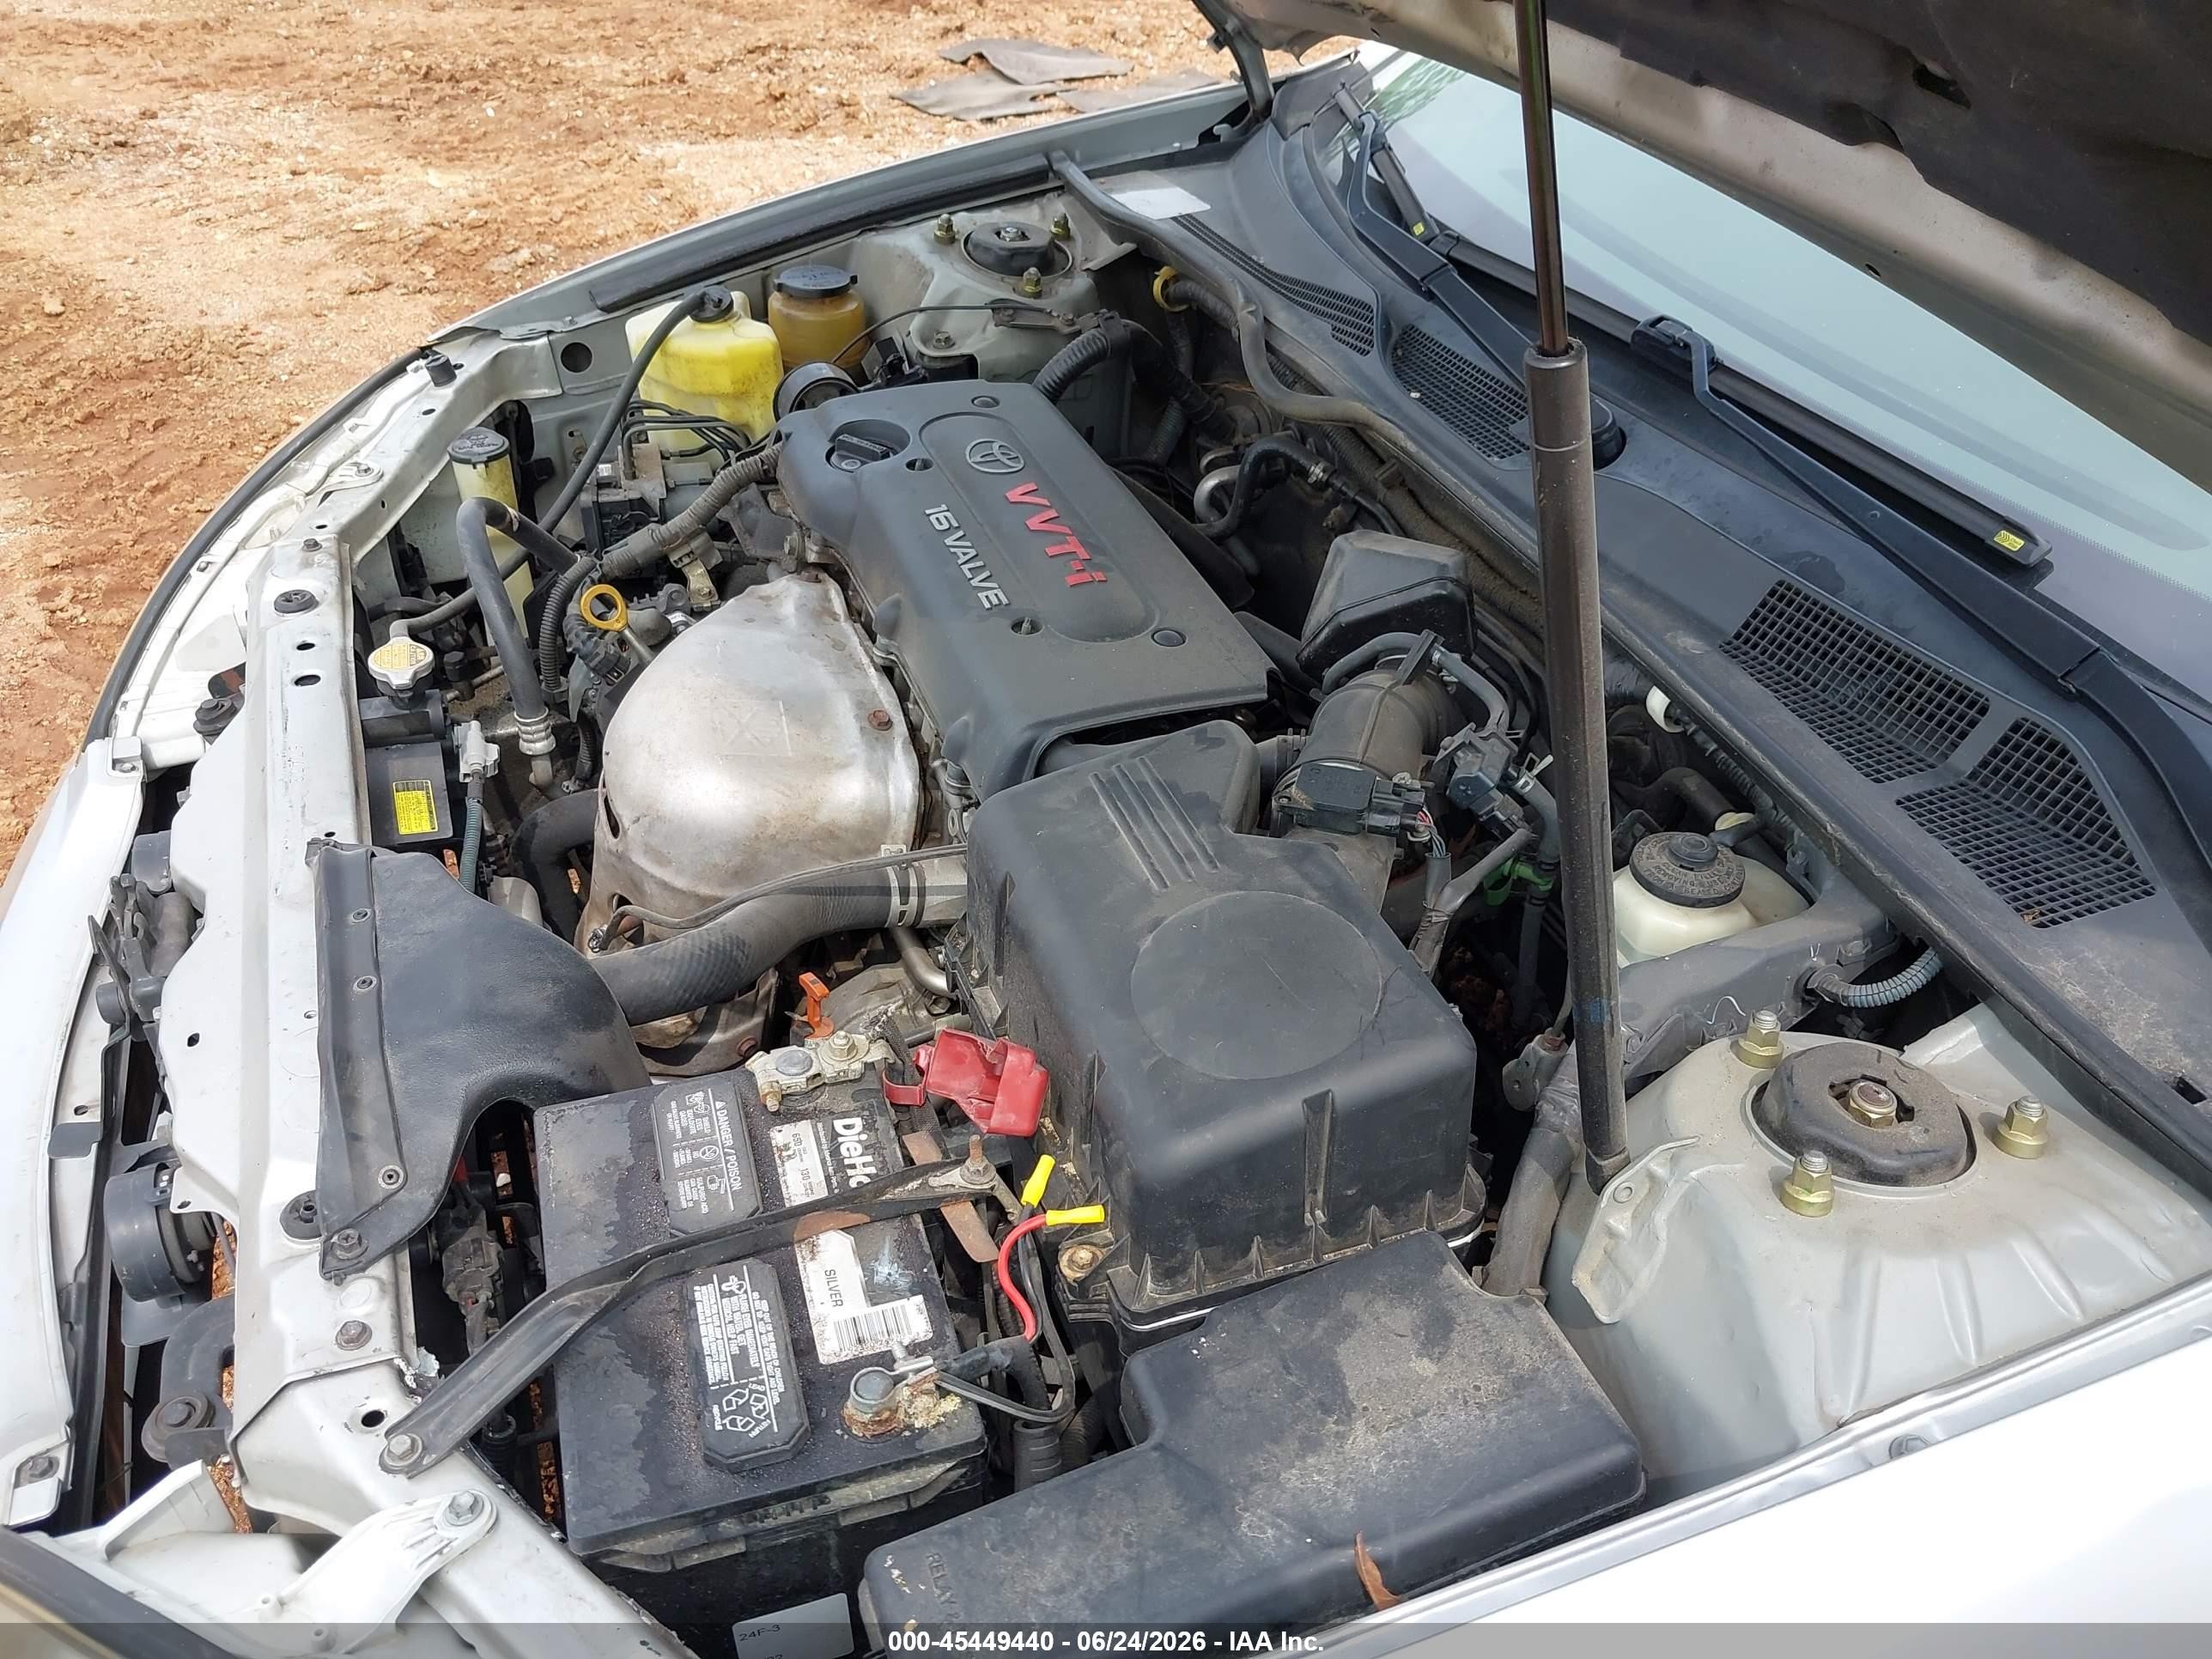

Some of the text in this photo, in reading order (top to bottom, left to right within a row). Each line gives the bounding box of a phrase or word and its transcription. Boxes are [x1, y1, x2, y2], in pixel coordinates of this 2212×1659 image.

[791, 1133, 803, 1146] 650
[715, 1109, 733, 1146] DANGER
[725, 1155, 742, 1190] POISON
[799, 1167, 811, 1180] 130
[824, 1268, 843, 1308] SILVER
[741, 1313, 752, 1328] EYES
[728, 1340, 738, 1354] FAST
[744, 1328, 759, 1367] IMMEDIATELY
[749, 1419, 771, 1438] RETURN
[926, 1551, 957, 1607] RELAY
